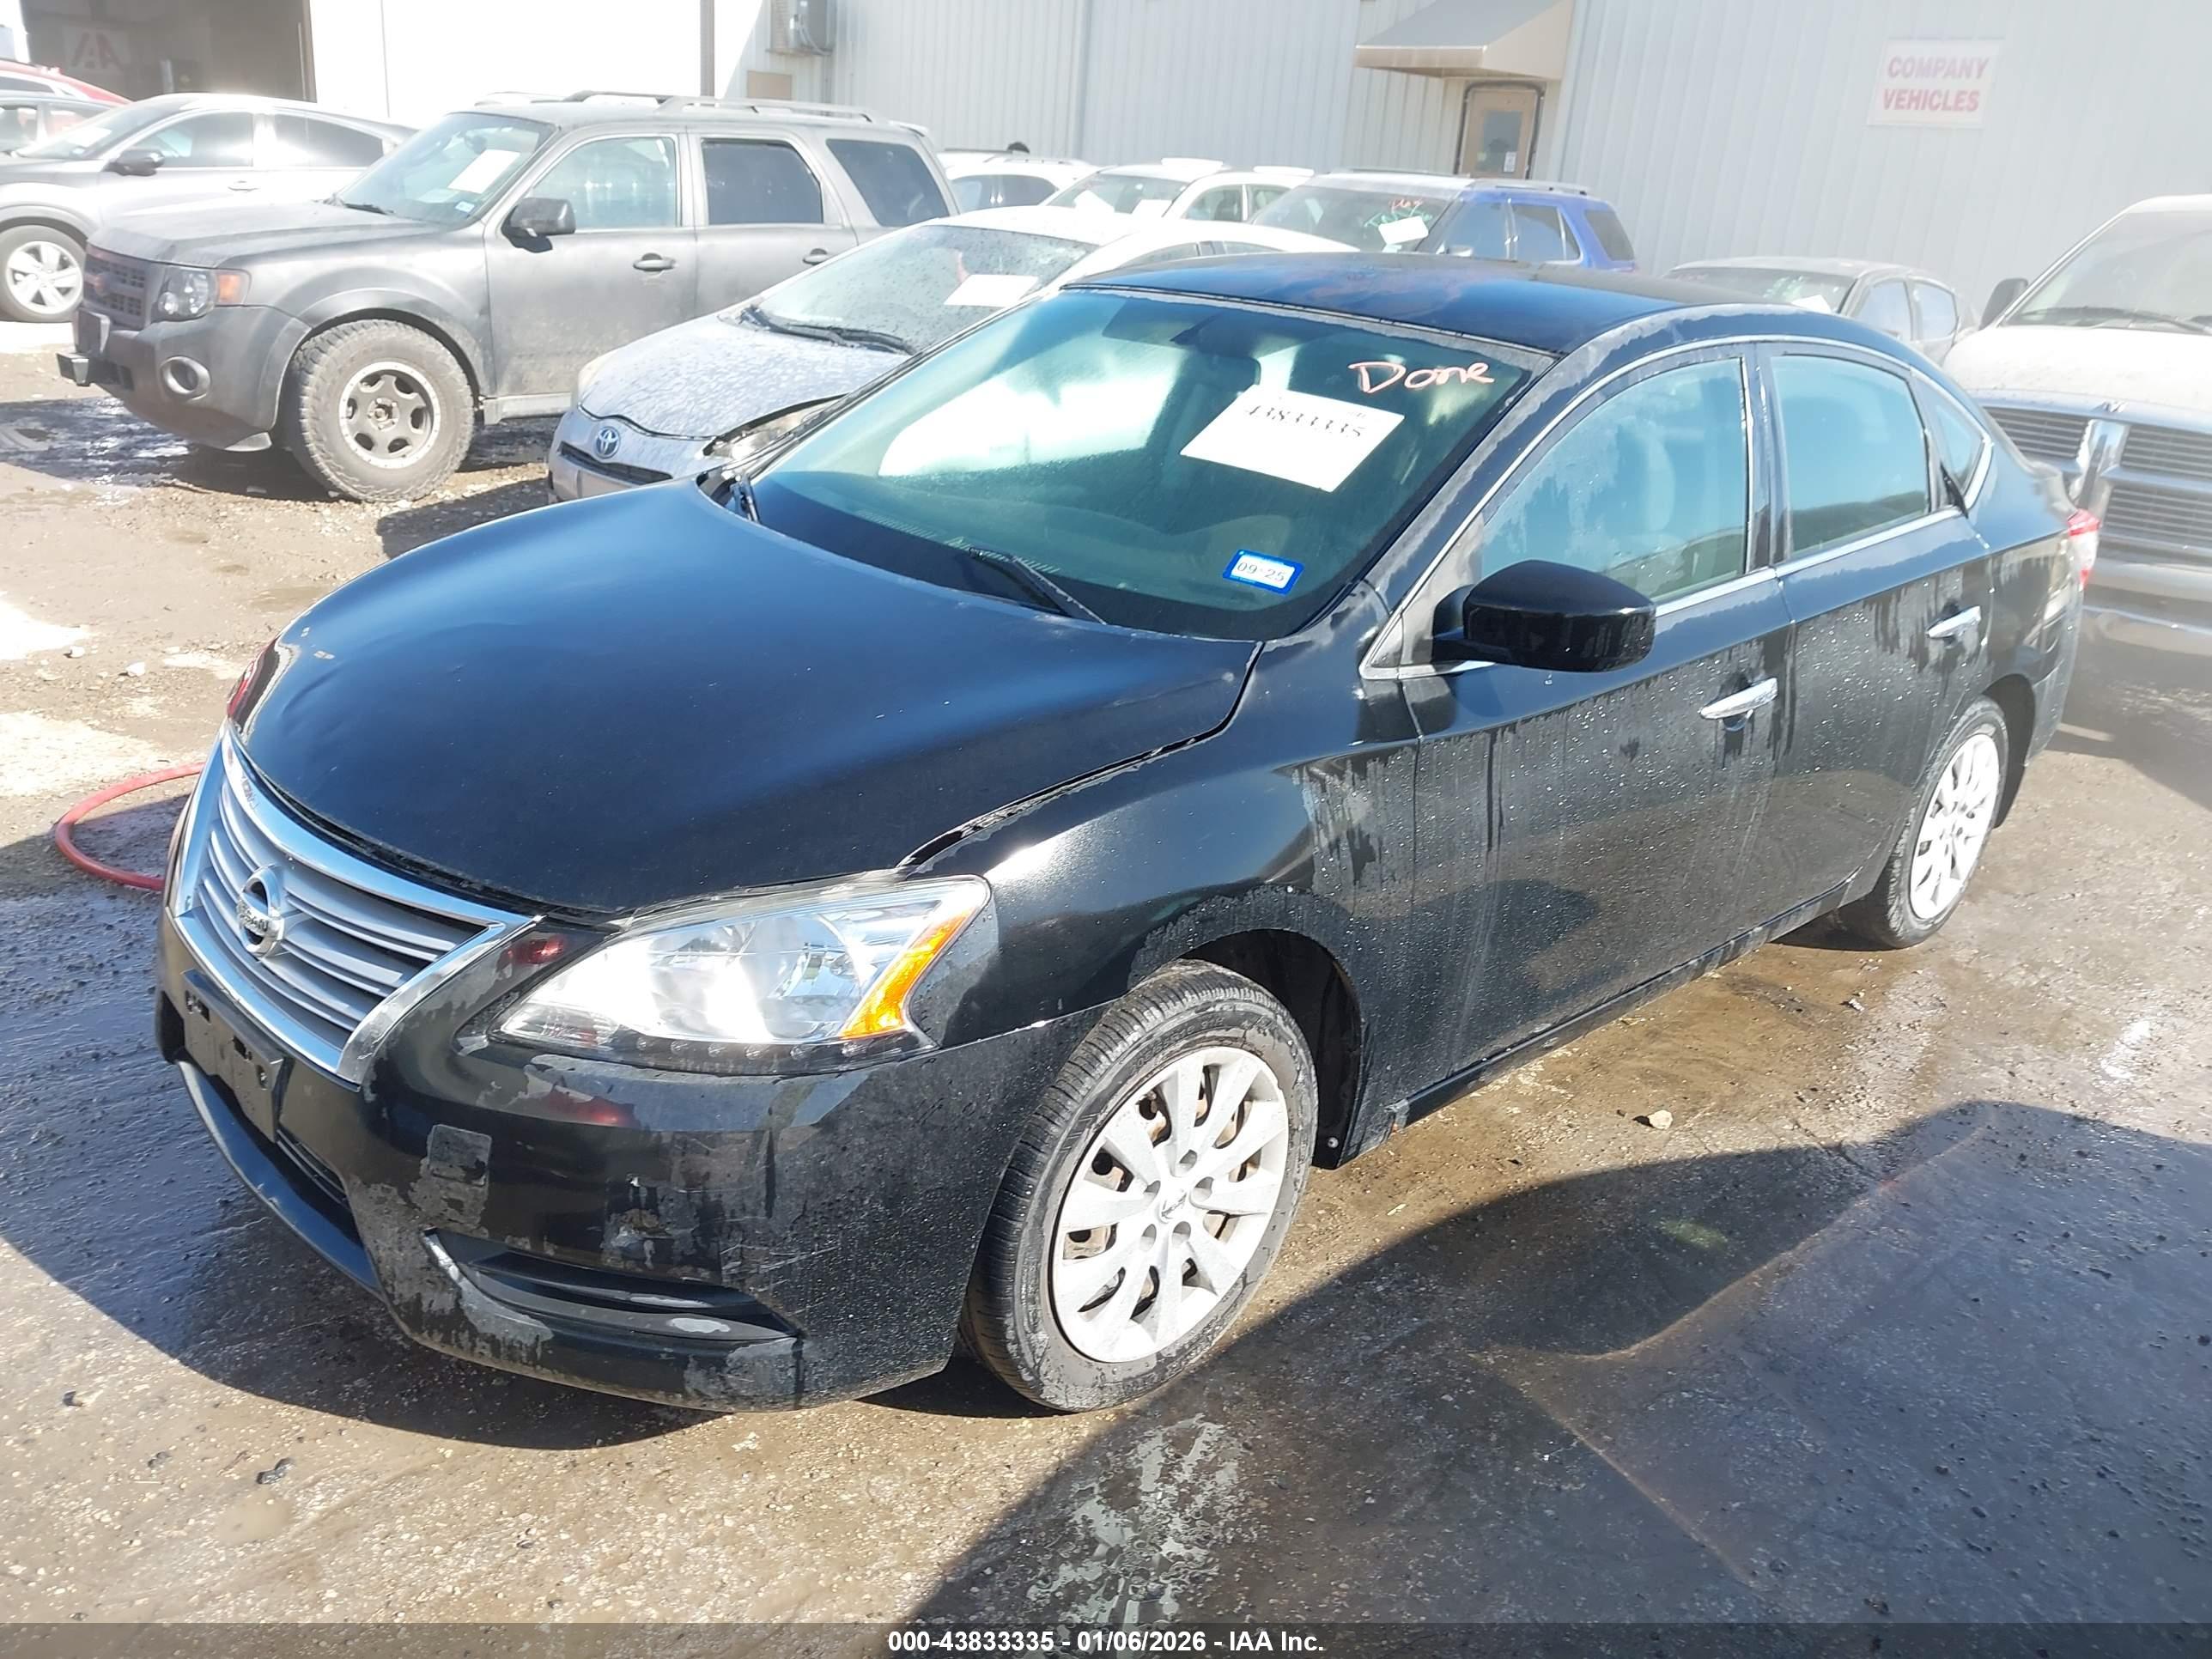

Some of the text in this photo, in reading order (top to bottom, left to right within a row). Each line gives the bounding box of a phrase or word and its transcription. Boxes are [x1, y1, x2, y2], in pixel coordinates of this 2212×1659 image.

[1888, 56, 1989, 79] COMPANY
[1882, 88, 1980, 112] VEHICLES
[1347, 361, 1495, 394] Done
